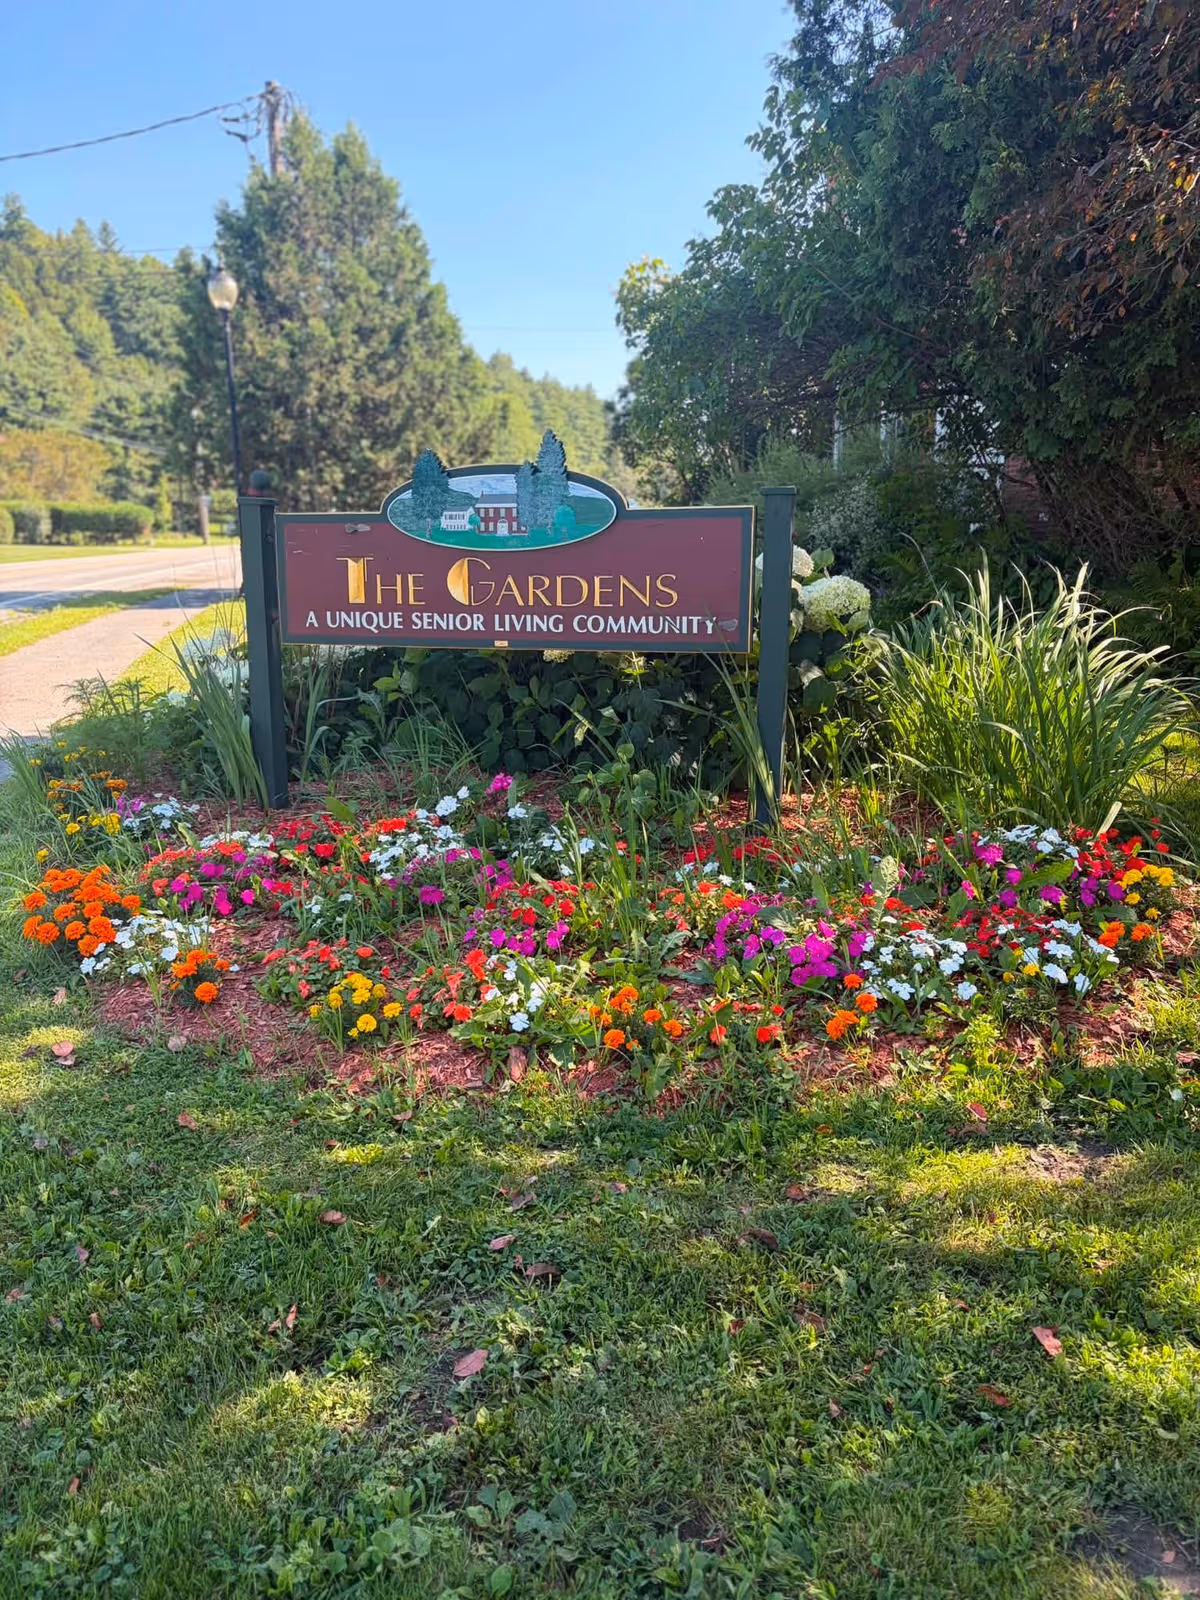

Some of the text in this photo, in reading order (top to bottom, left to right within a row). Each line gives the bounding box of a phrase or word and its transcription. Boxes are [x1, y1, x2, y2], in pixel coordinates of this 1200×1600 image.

[336, 557, 679, 608] THE GARDENS
[306, 611, 716, 634] A UNIQUE SENIOR LIVING COMMUNITY
